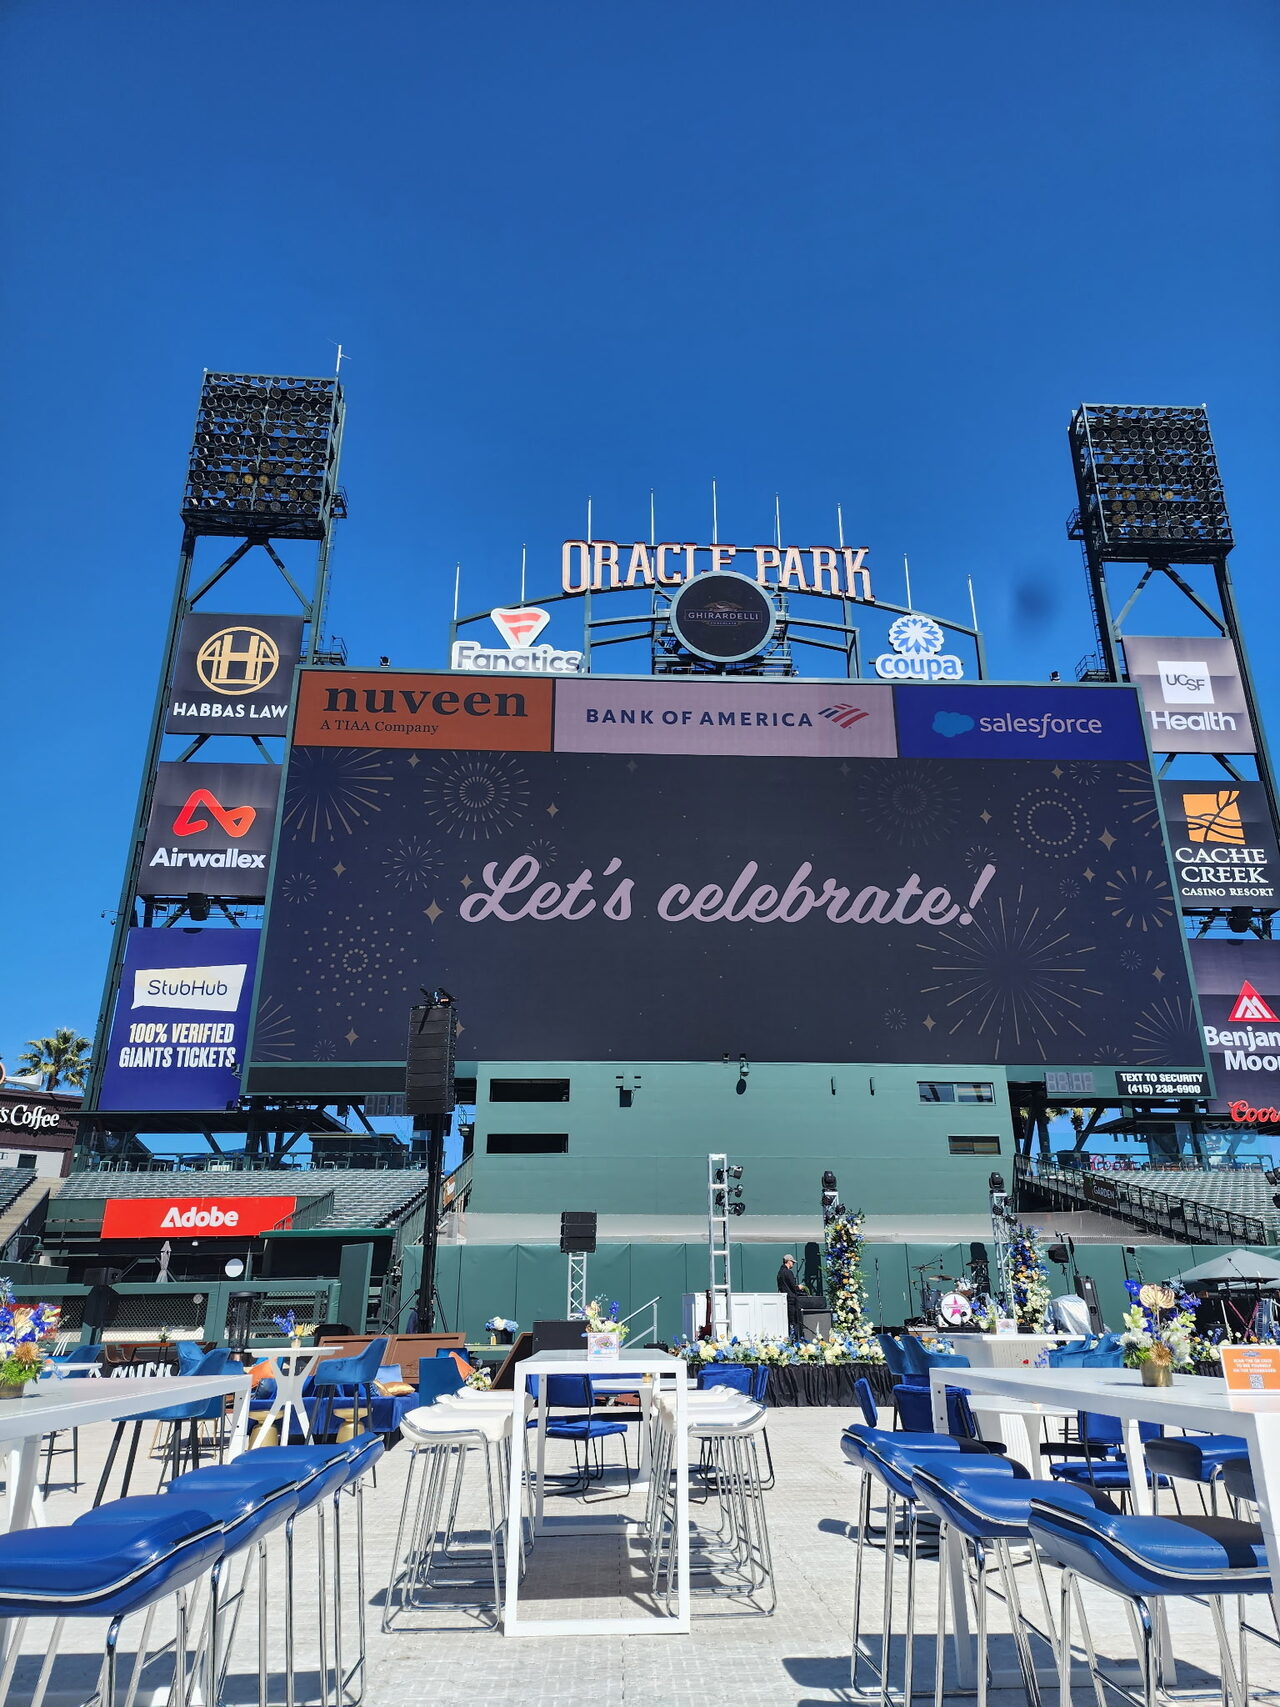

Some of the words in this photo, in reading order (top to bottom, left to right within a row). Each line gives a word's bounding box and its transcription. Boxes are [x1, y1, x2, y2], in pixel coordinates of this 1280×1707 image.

[754, 545, 875, 601] PARK
[688, 612, 758, 620] GHIRARDELLI
[457, 648, 580, 674] Fanatics
[881, 655, 960, 678] coupa
[1165, 673, 1205, 691] UCSF
[173, 702, 245, 718] HABBAS
[250, 704, 288, 718] LAW
[323, 687, 529, 717] nuveen
[320, 719, 331, 731] A
[334, 720, 371, 731] TIAA
[374, 720, 439, 736] Company
[586, 708, 654, 725] BANK
[662, 710, 692, 725] OF
[699, 711, 813, 727] AMERICA
[979, 713, 1102, 738] salesforce
[1150, 710, 1237, 731] Health
[149, 847, 267, 869] Airwallex
[1175, 847, 1268, 864] CACHE
[1181, 866, 1269, 883] CREEK
[459, 853, 636, 924] Let's
[656, 860, 997, 926] celebrate!
[1181, 887, 1226, 896] CASINO
[1229, 888, 1274, 897] RESORT
[147, 980, 228, 996] StubHub
[129, 1023, 168, 1044] 100%
[171, 1023, 235, 1044] VERIFIED
[119, 1046, 173, 1068] GIANTS
[176, 1047, 236, 1068] TICKETS
[1224, 1050, 1280, 1071] Moo
[1120, 1073, 1143, 1082] TEXT
[1146, 1073, 1158, 1082] TO
[1159, 1073, 1203, 1083] SECURITY
[1128, 1084, 1153, 1095] (415)
[1155, 1084, 1201, 1094] 238-6900
[10, 1104, 60, 1130] Coffee
[1228, 1100, 1280, 1122] Coor
[1093, 1185, 1116, 1199] GARDEN
[160, 1206, 239, 1228] Adobe
